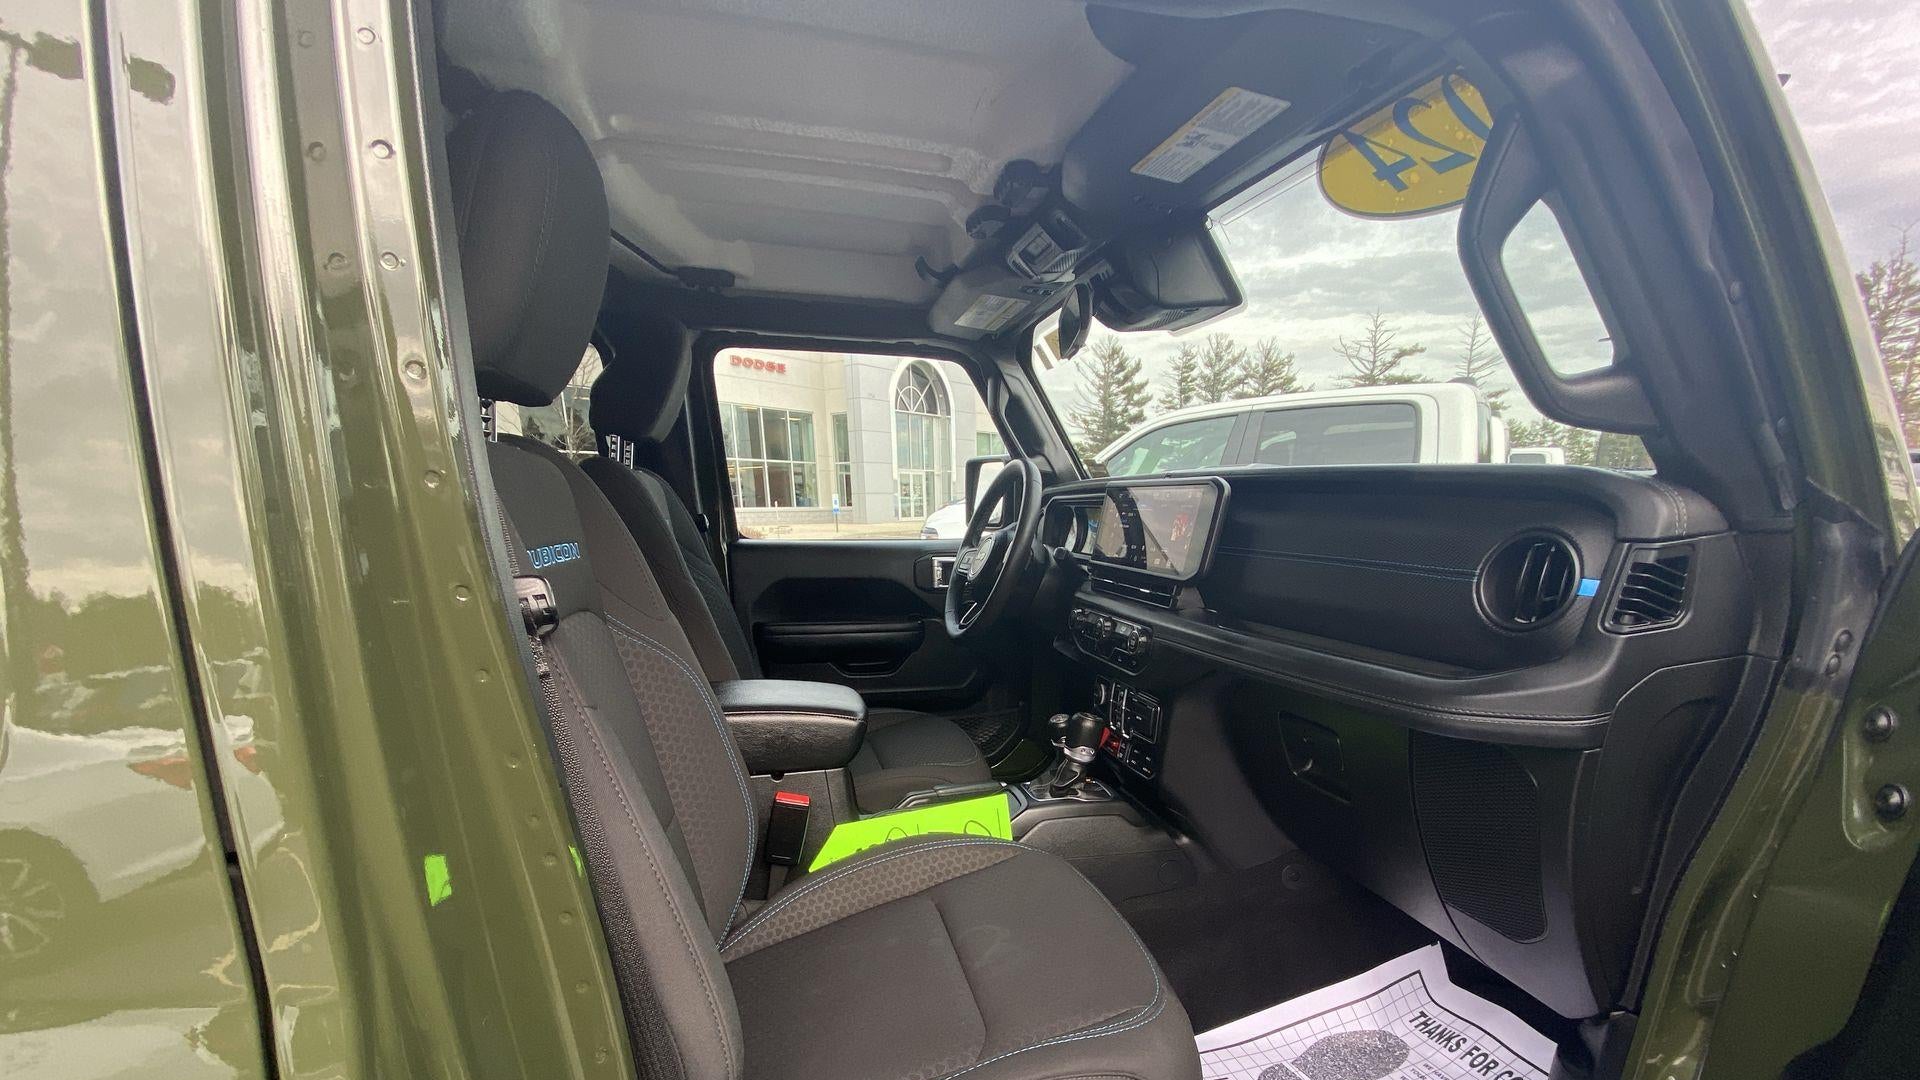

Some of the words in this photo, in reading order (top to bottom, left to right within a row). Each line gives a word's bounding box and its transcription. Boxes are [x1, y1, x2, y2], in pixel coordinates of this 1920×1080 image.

[730, 355, 786, 373] DODGE
[526, 542, 581, 569] UBICON
[1409, 1010, 1467, 1053] THANKS
[1460, 1045, 1500, 1077] FOR
